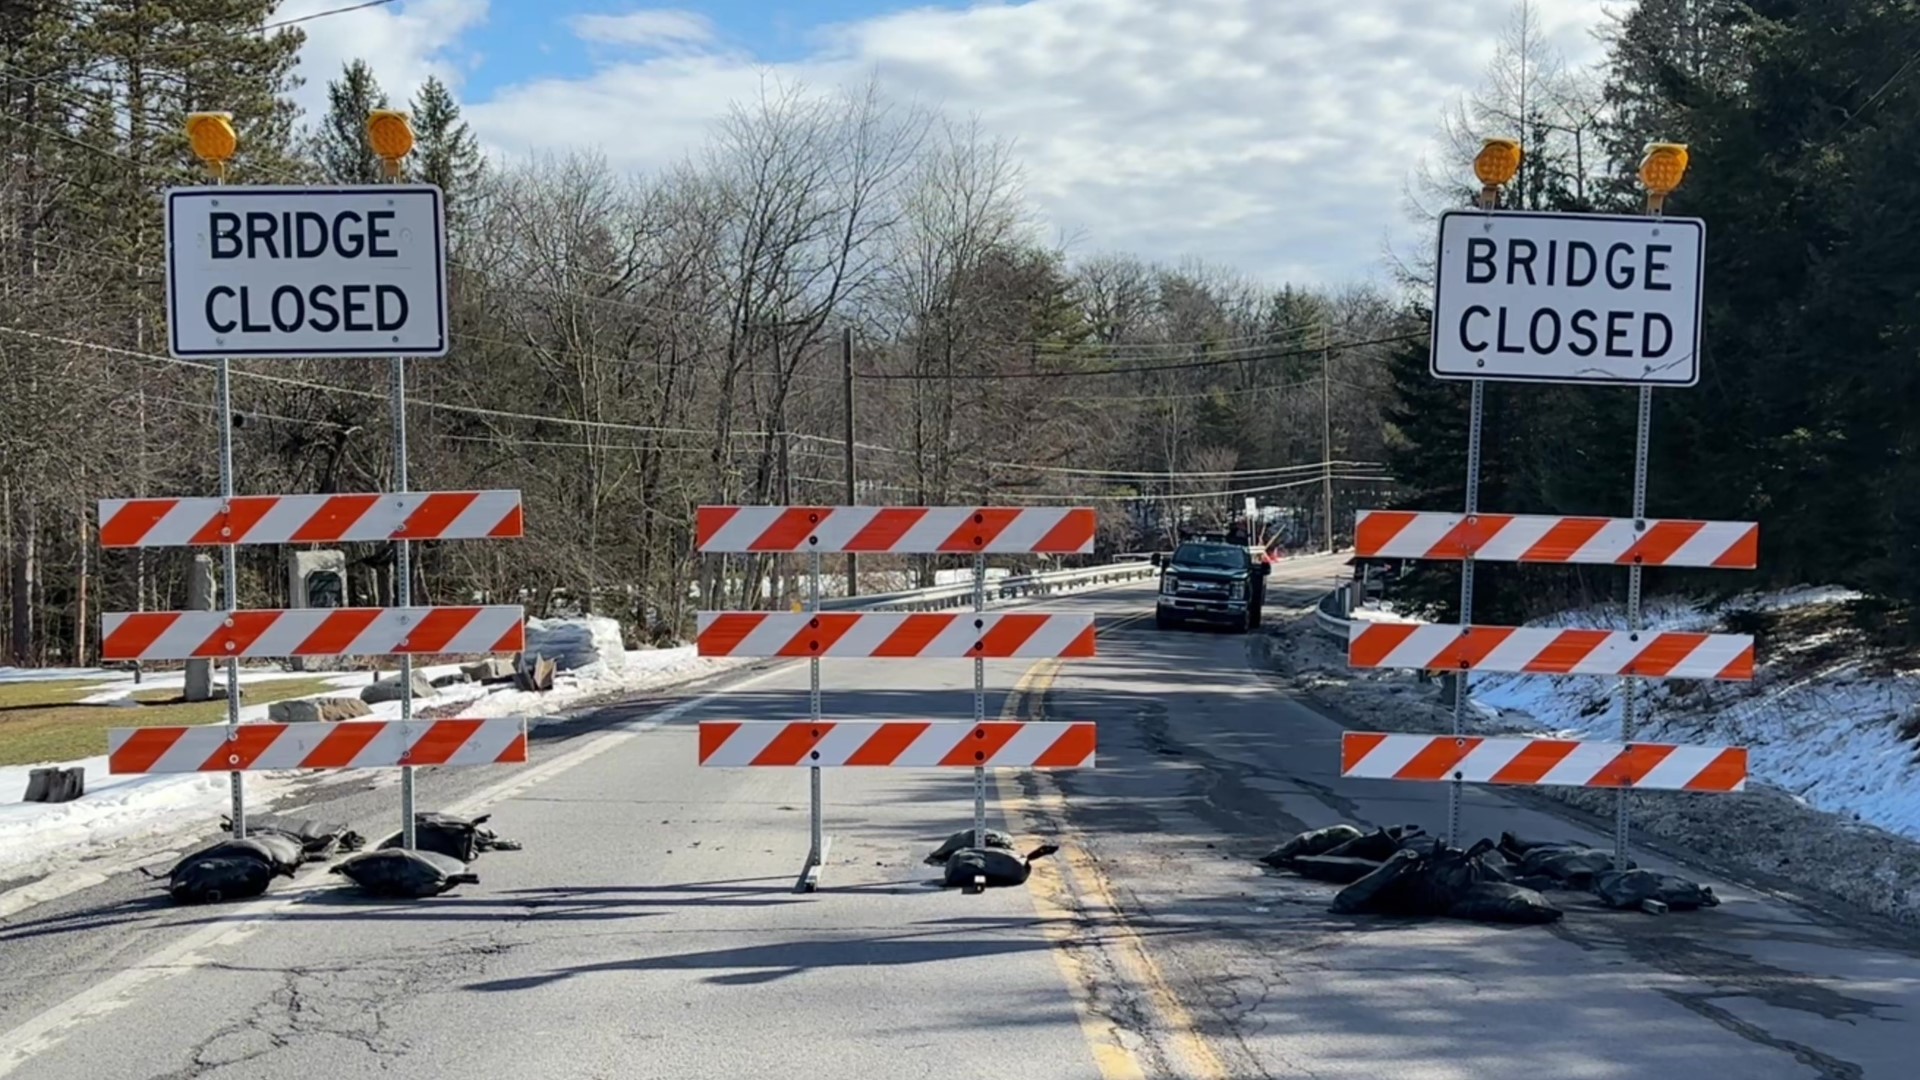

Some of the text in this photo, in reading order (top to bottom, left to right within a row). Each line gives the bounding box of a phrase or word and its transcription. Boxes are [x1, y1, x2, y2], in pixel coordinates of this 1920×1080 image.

[209, 210, 398, 258] BRIDGE
[1466, 237, 1672, 291] BRIDGE
[205, 284, 409, 333] CLOSED
[1459, 304, 1673, 358] CLOSED
